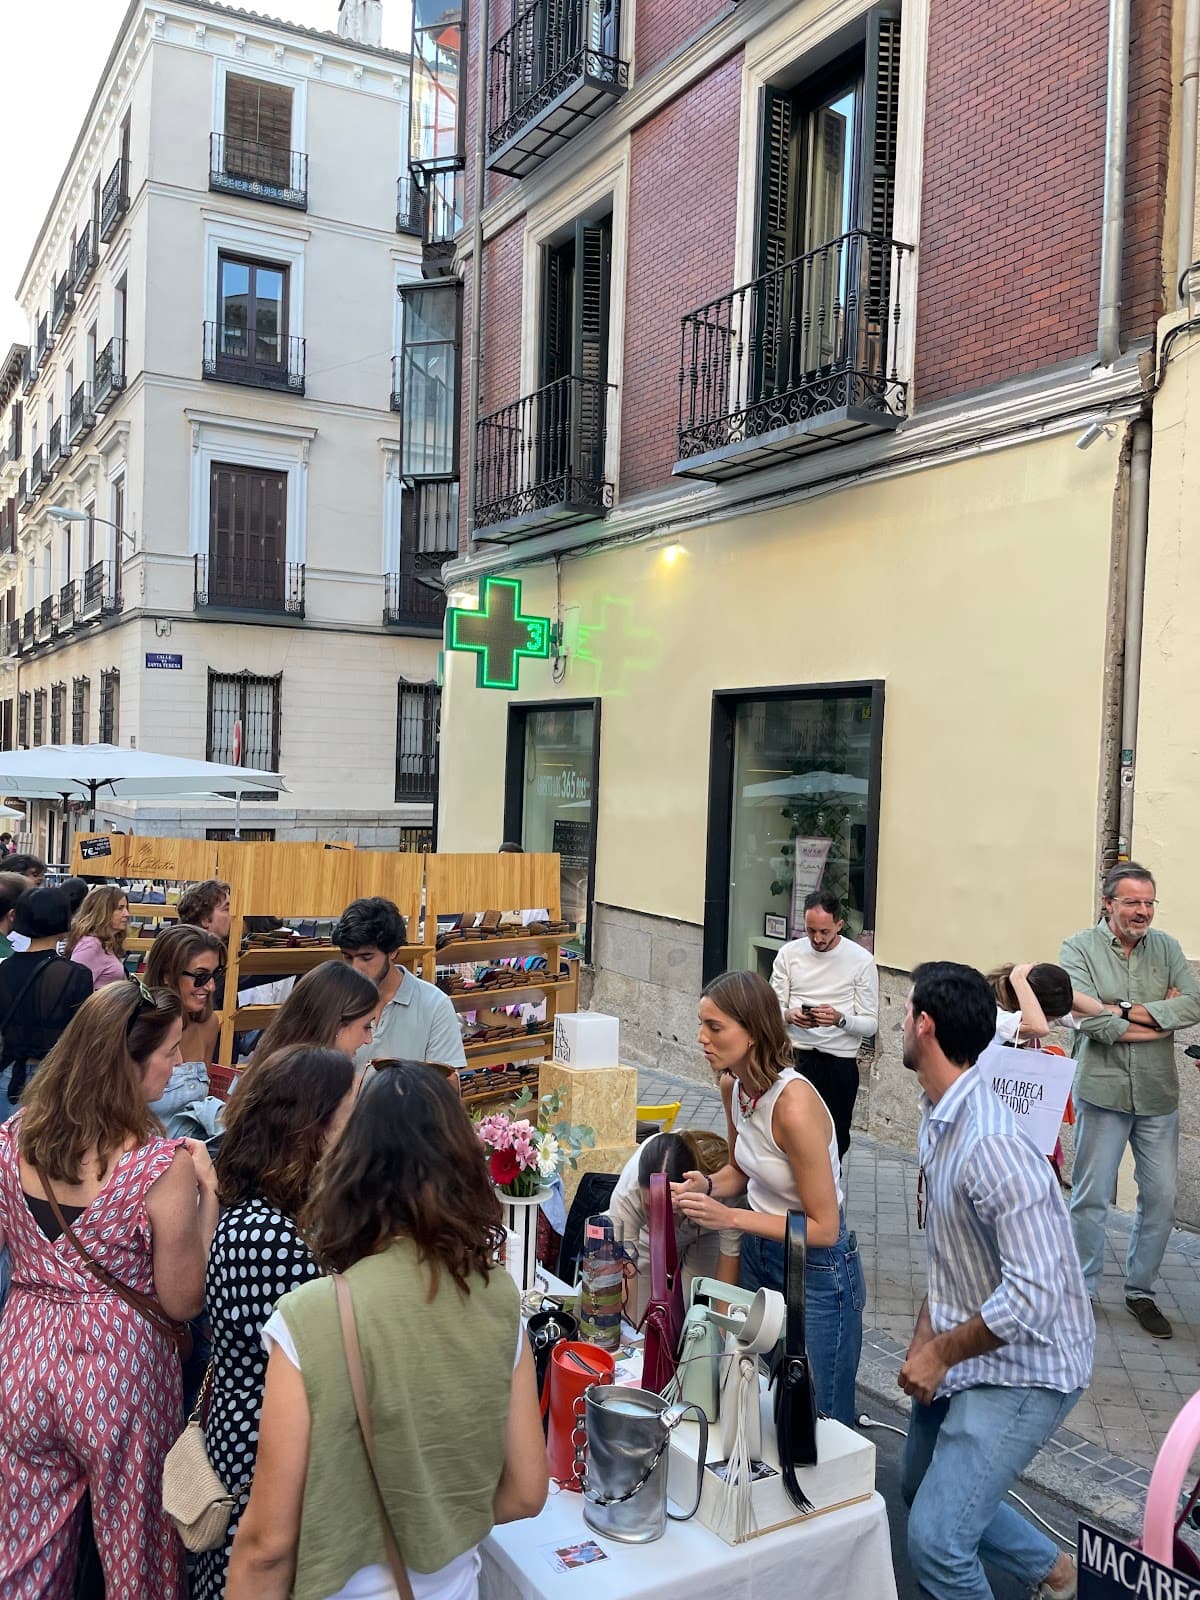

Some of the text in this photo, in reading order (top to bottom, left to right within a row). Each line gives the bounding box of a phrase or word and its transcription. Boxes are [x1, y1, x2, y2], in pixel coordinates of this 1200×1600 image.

[527, 623, 542, 651] 3
[561, 769, 576, 799] 365
[992, 1076, 1043, 1101] MACABECA
[1081, 1529, 1200, 1600] MACABE
